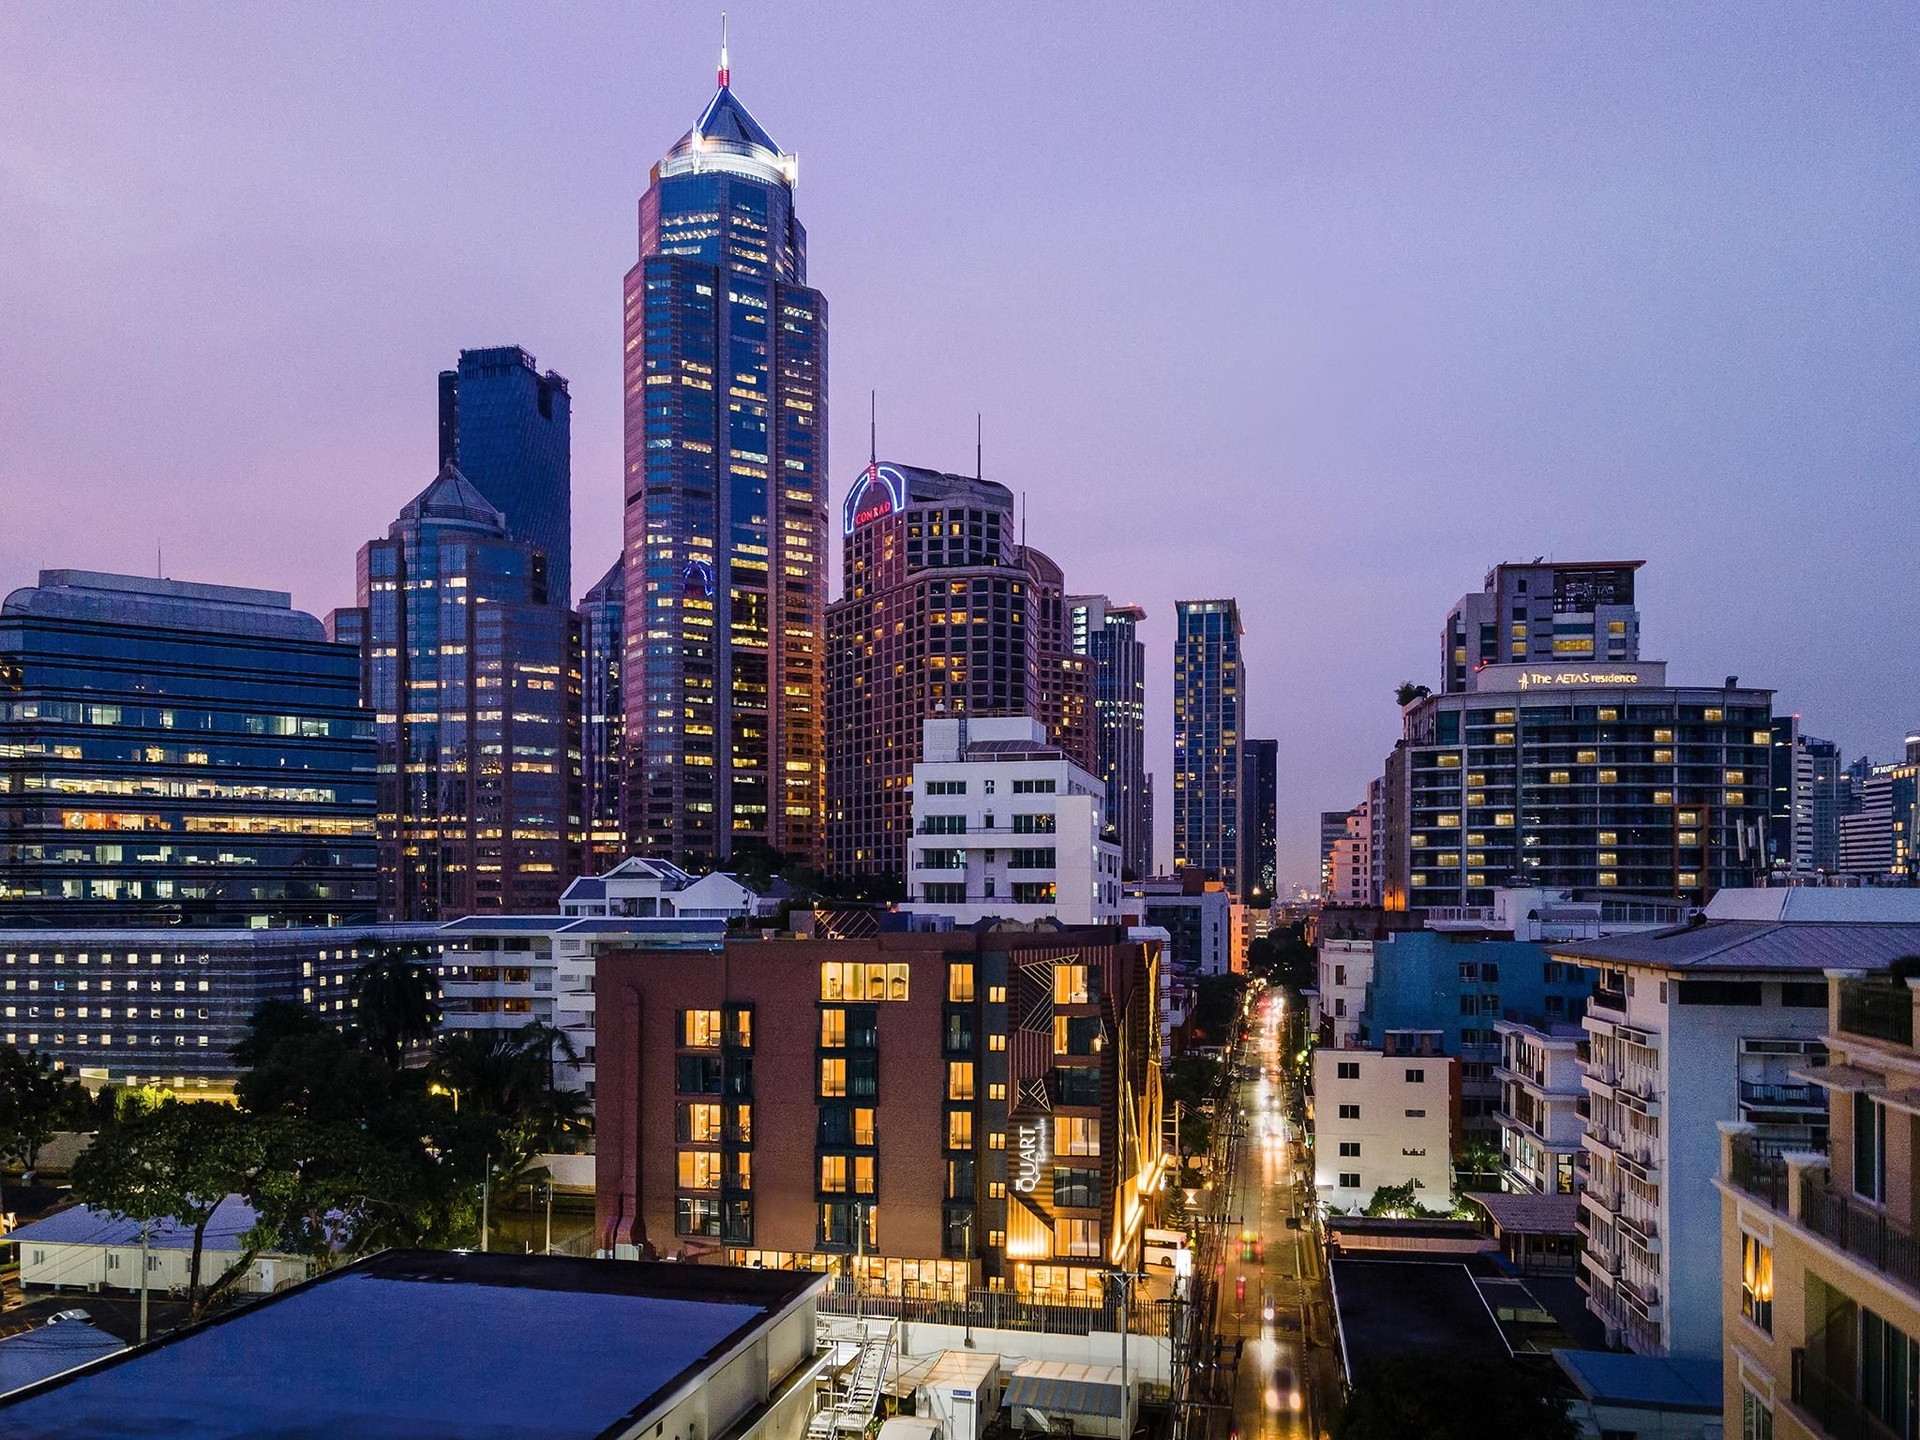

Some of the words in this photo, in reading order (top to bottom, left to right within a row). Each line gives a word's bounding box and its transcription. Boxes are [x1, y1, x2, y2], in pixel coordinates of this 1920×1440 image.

[855, 501, 891, 525] CONRAD
[1531, 673, 1552, 684] The
[1555, 673, 1589, 684] AETAS
[1591, 673, 1637, 683] residence
[1019, 1126, 1041, 1192] QUART
